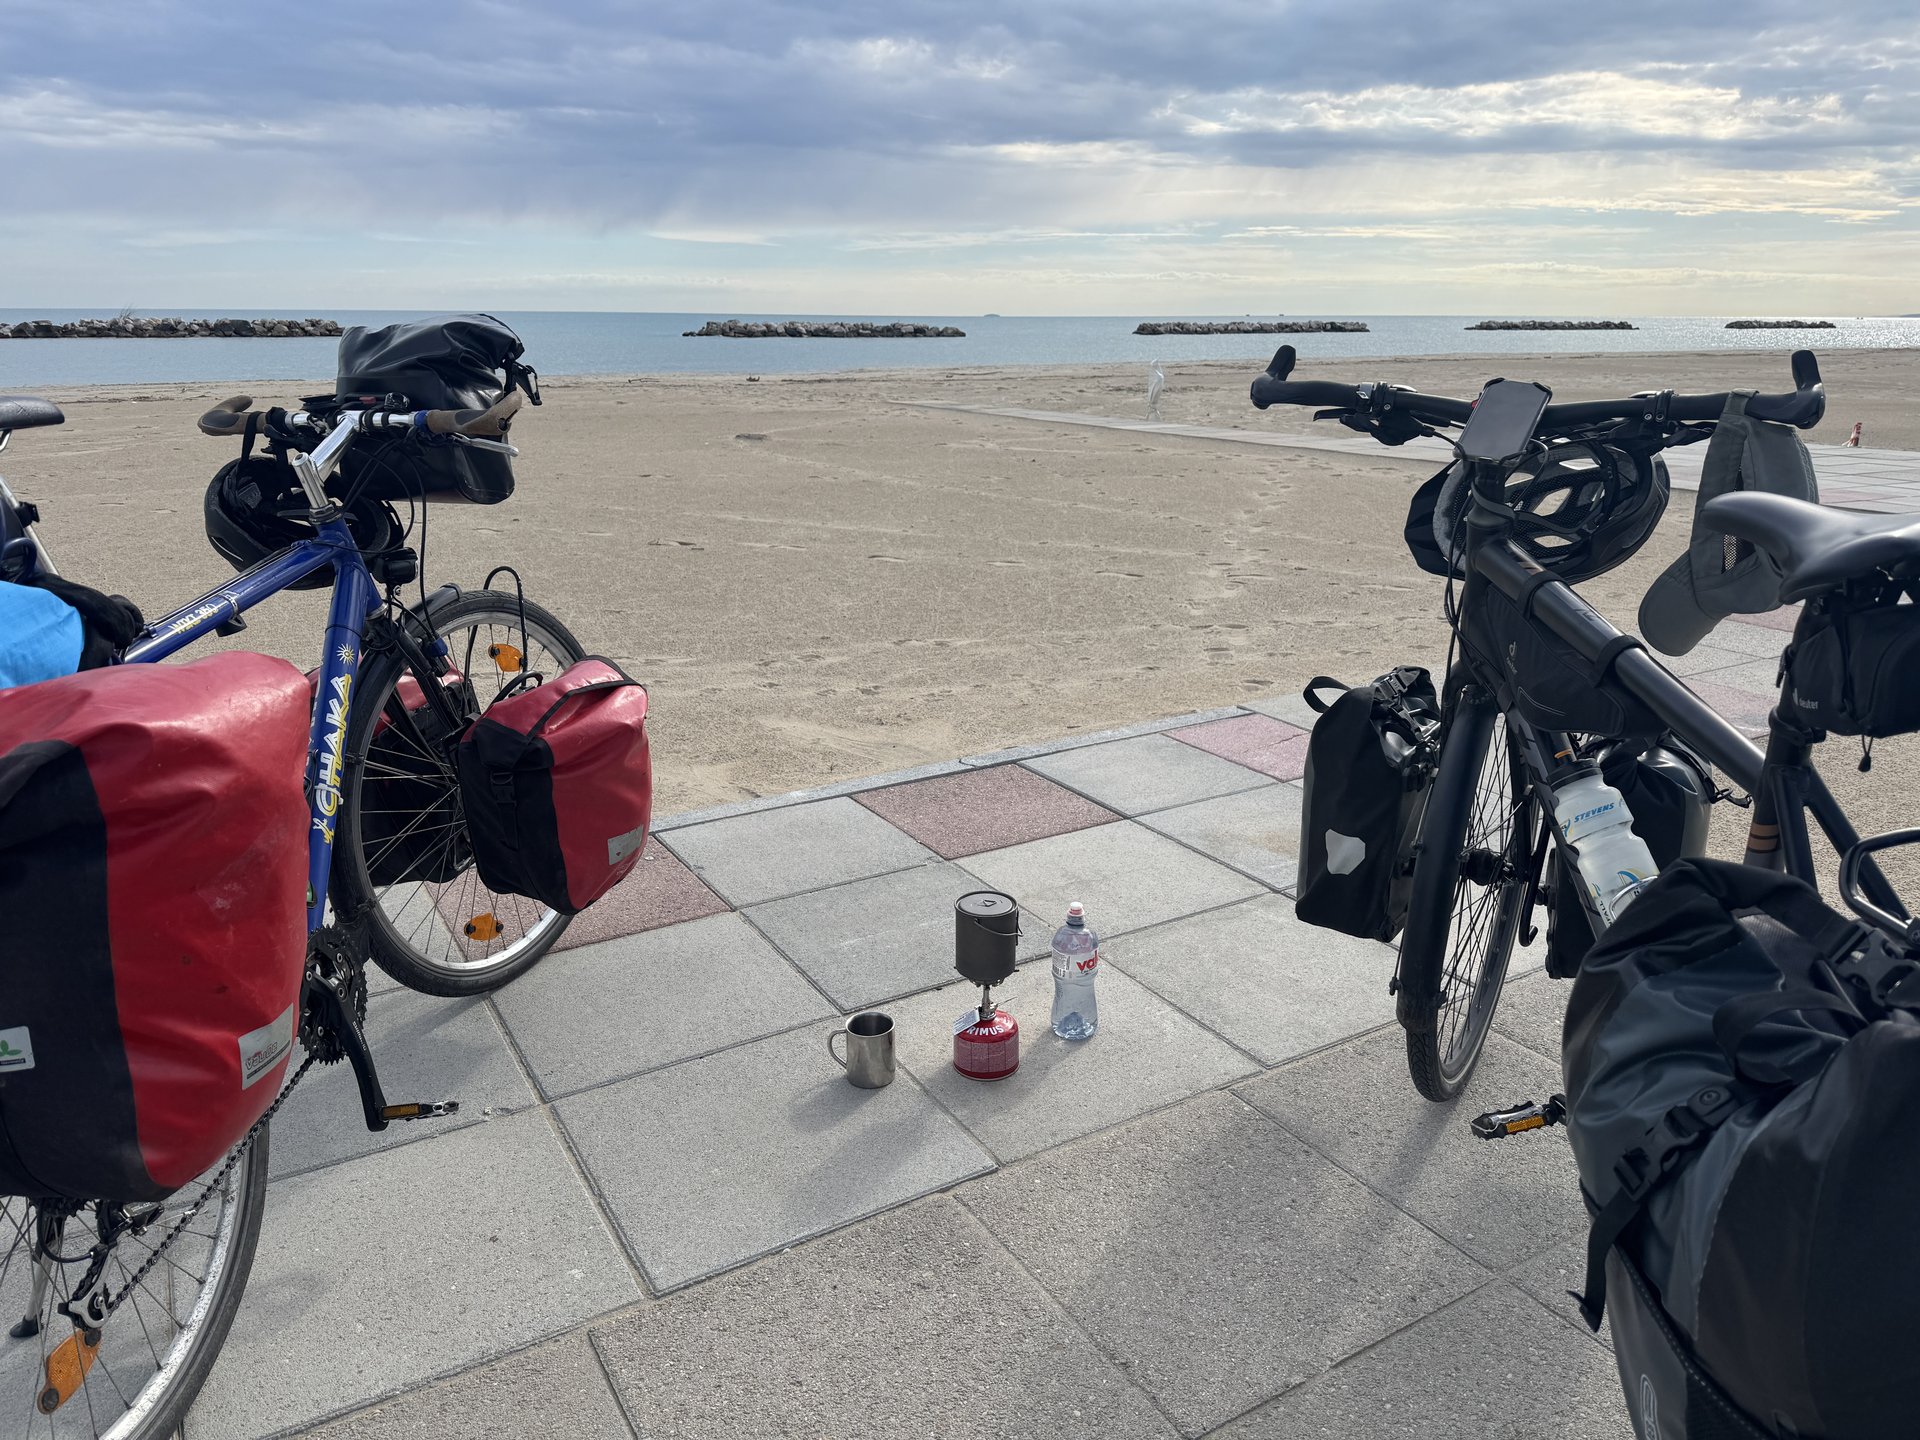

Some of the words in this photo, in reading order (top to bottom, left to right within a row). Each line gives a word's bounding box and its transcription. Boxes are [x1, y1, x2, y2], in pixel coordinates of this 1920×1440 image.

[315, 673, 352, 817] CHAKA
[1574, 802, 1615, 823] STEVENS
[966, 1025, 1005, 1036] RIMUS
